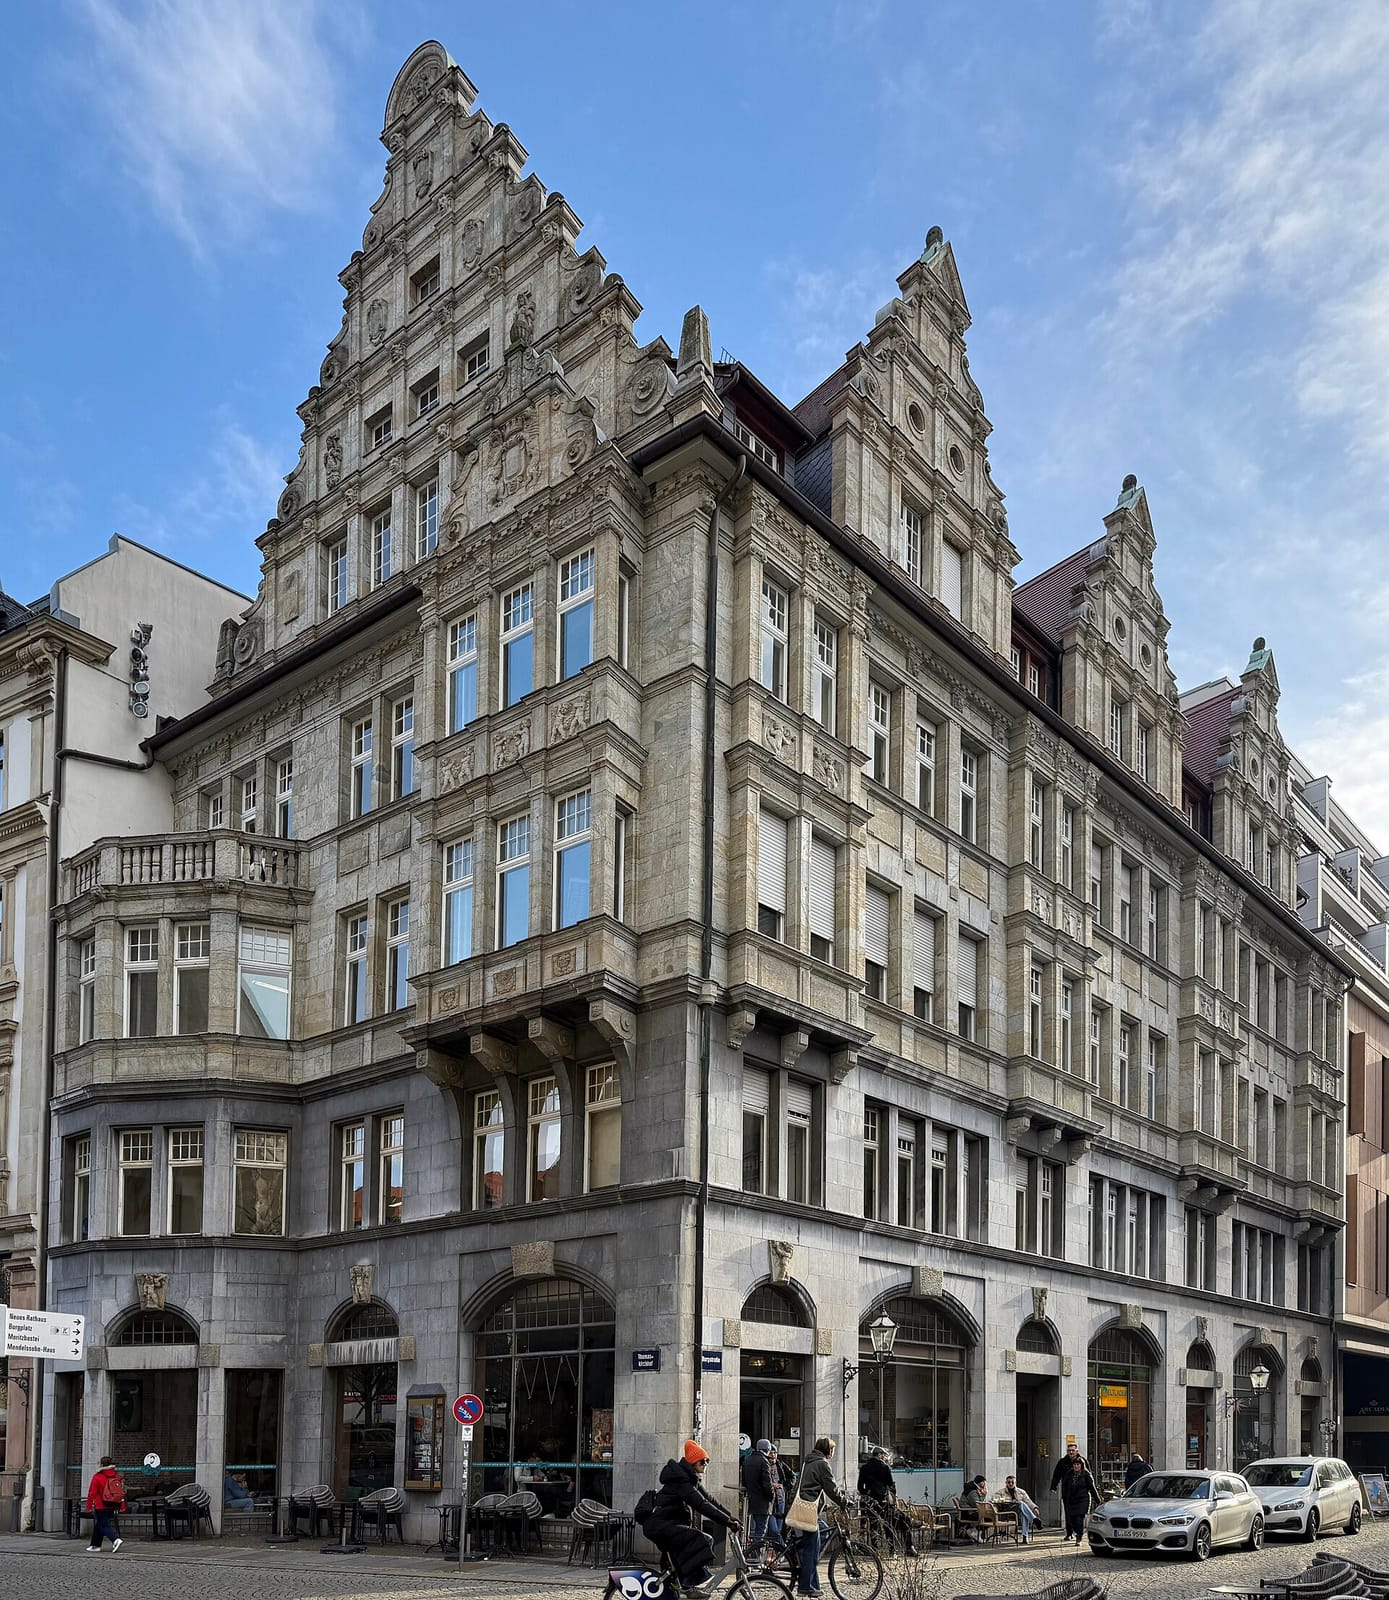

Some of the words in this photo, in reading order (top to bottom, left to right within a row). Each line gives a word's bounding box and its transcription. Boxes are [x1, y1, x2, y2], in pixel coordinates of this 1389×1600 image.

[9, 1323, 32, 1331] Burgplatz
[8, 1333, 39, 1342] Moritzbastei
[7, 1343, 55, 1353] Mendelssohn-Haus
